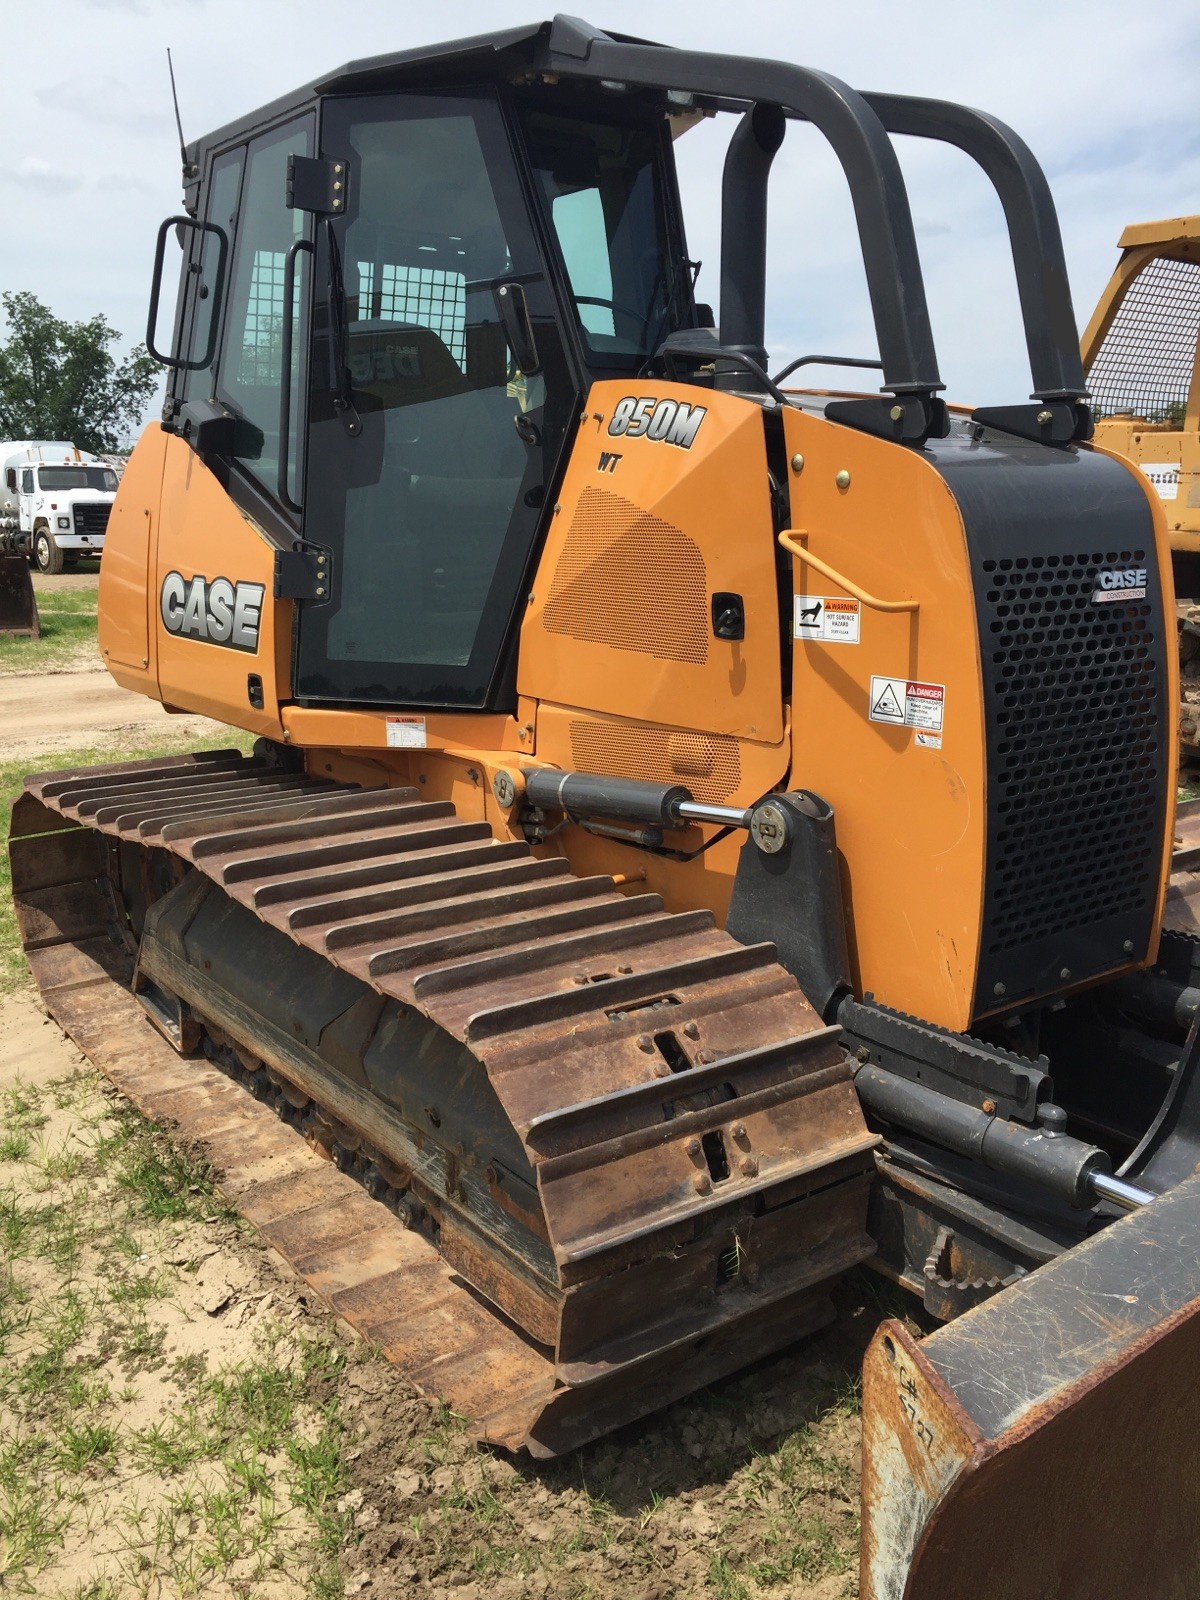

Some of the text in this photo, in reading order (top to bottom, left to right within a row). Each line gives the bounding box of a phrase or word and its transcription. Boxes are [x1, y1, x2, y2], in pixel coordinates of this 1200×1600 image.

[608, 396, 707, 449] 850M
[598, 452, 623, 473] WT
[1100, 569, 1147, 589] CASE
[1106, 590, 1145, 599] CONSTRUCTION
[161, 571, 264, 651] CASE
[831, 603, 858, 611] WARNING
[916, 687, 943, 699] DANGER
